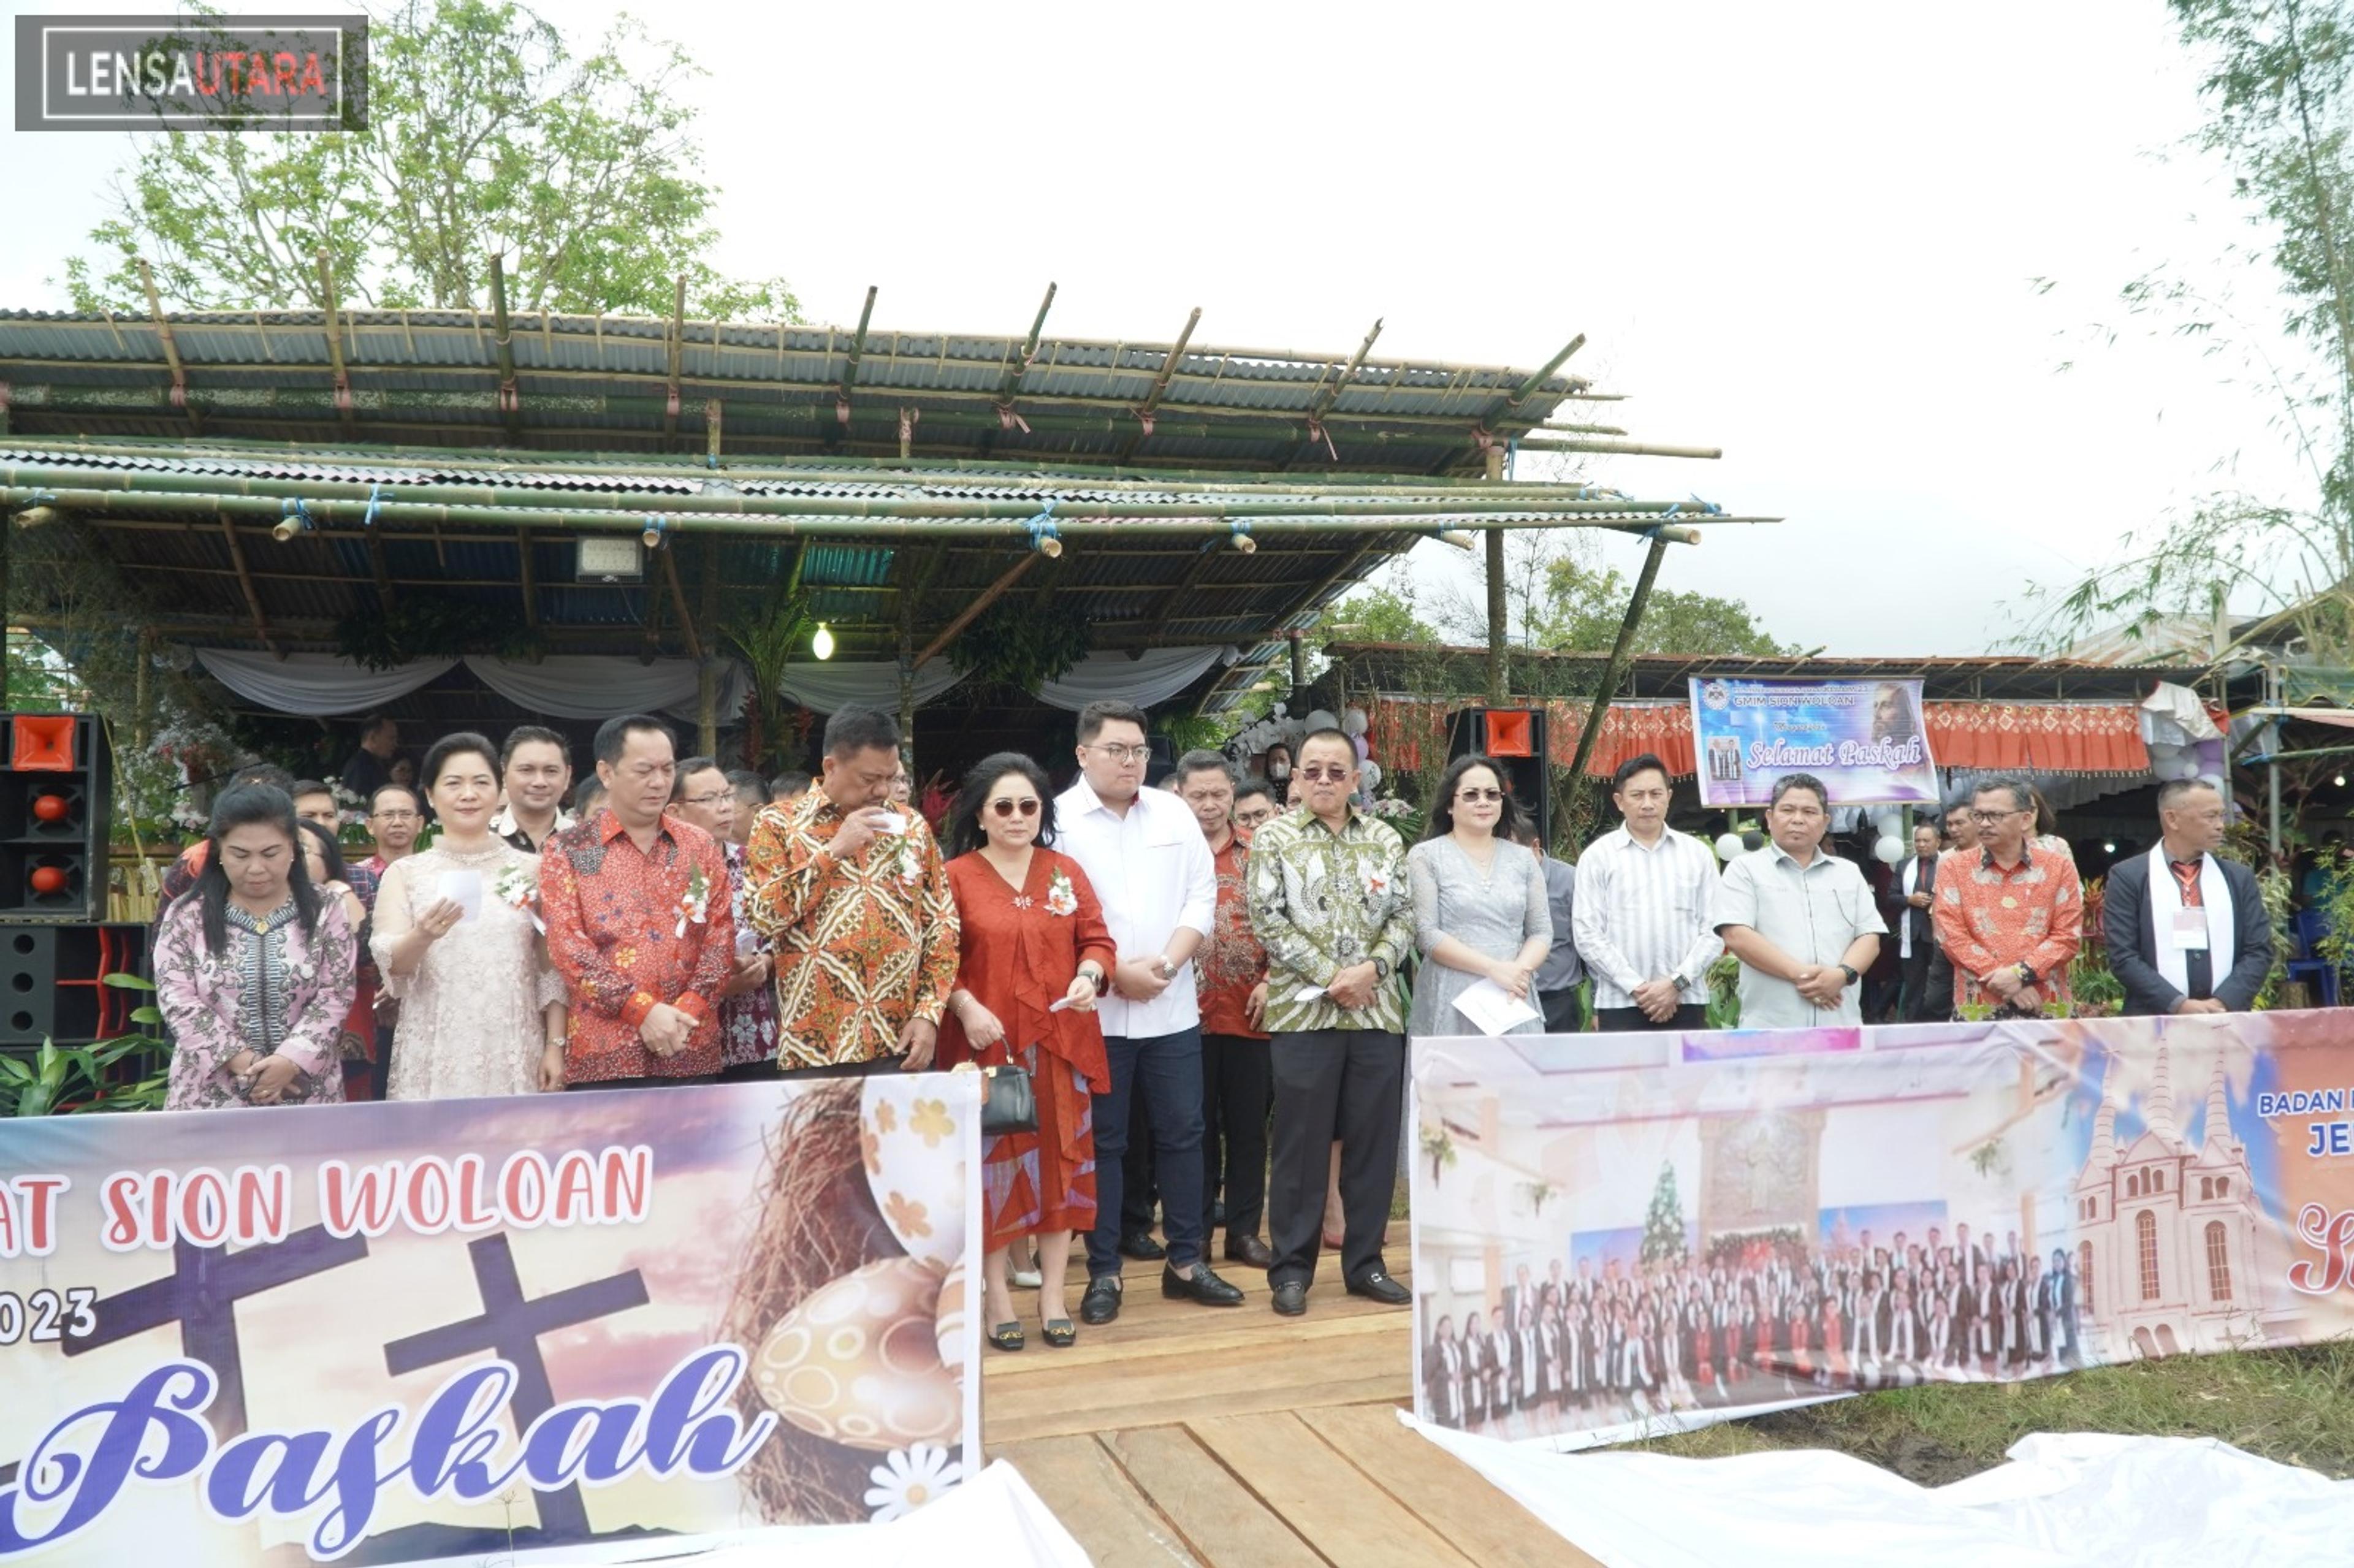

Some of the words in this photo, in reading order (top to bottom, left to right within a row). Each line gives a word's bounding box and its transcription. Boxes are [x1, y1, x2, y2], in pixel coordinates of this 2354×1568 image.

[1734, 696, 1766, 707] GMIM
[1769, 696, 1797, 707] SION
[1799, 695, 1854, 707] WOLOAN
[1748, 738, 1834, 768] Selamat
[1839, 736, 1921, 770] Paskah
[2259, 1089, 2344, 1115] BADAN
[2309, 1123, 2354, 1155] JE
[108, 1168, 287, 1246] SION
[324, 1150, 647, 1233] WOLOAN
[0, 1348, 772, 1557] Paskah
